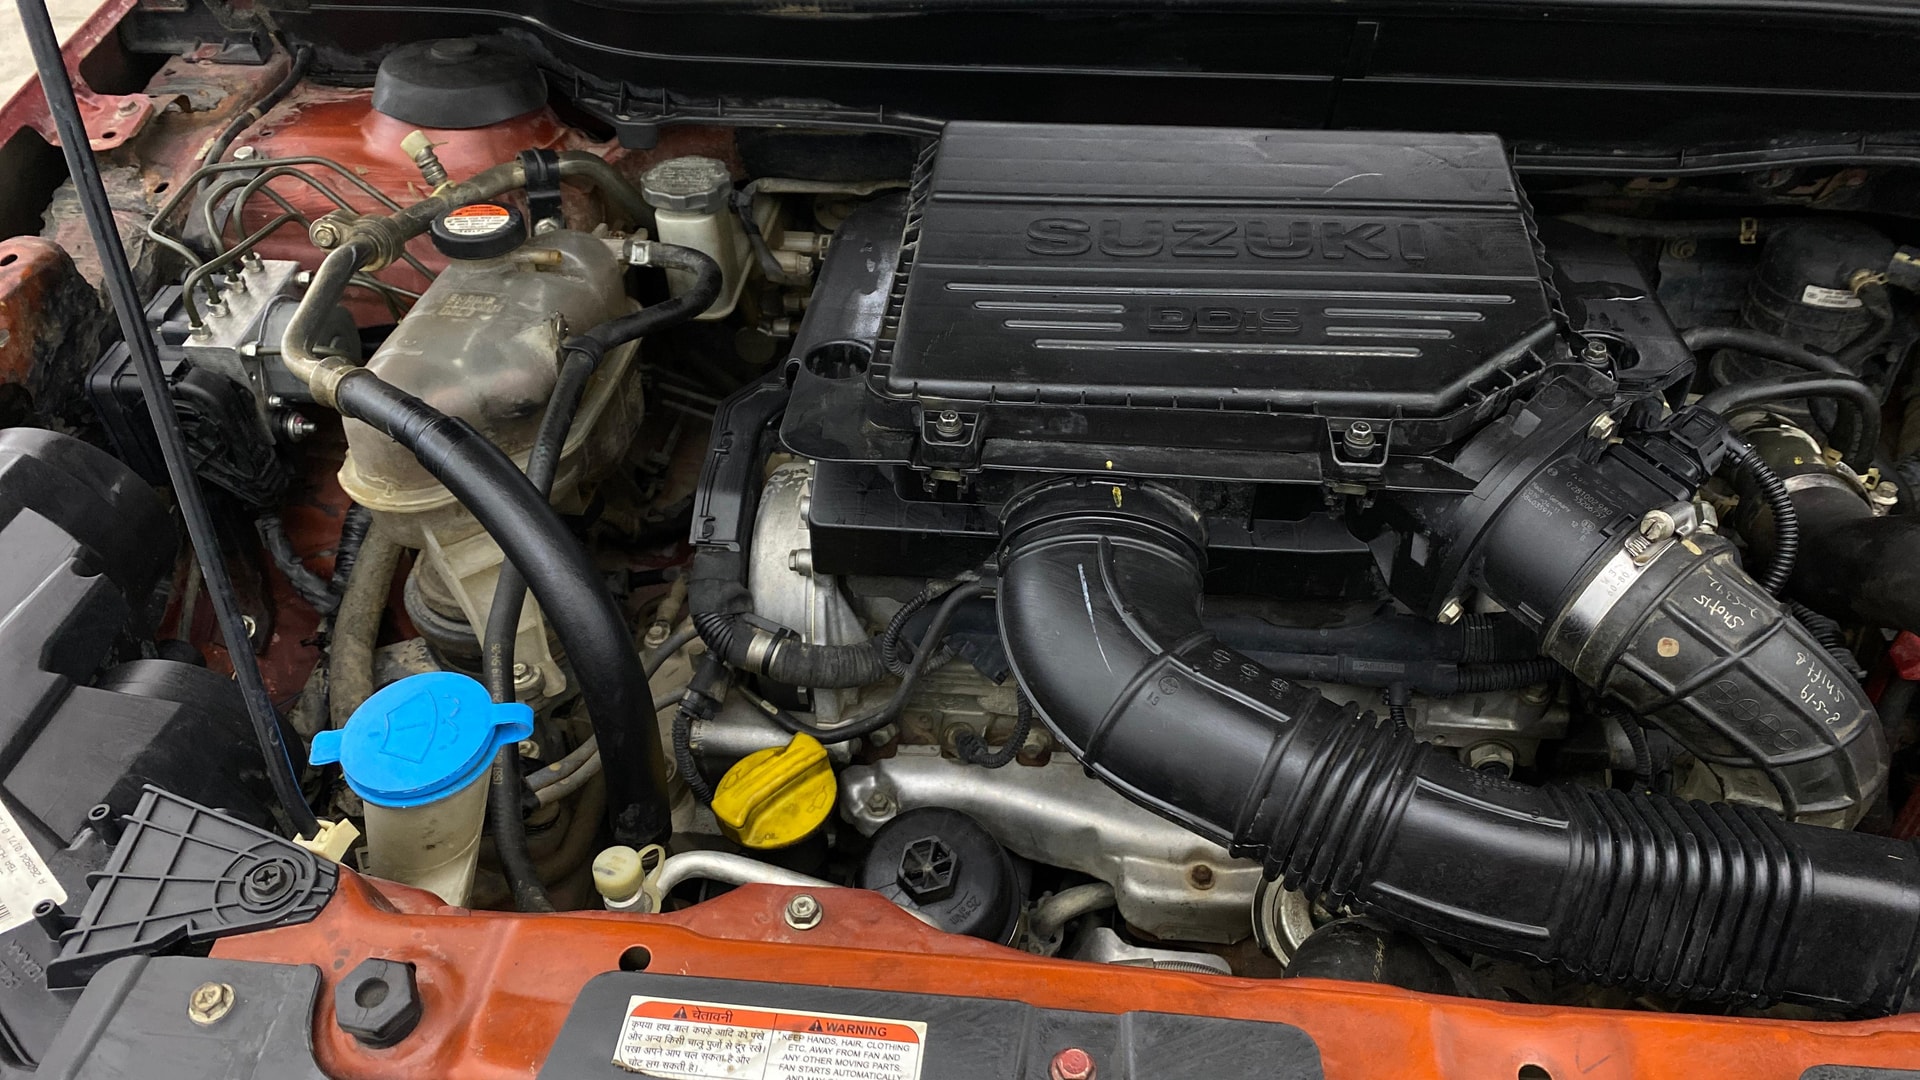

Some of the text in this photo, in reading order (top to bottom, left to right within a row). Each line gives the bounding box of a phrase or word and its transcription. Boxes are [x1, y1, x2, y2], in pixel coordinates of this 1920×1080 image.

[1025, 218, 1427, 260] SUZUKI
[1147, 306, 1302, 333] DDiS
[692, 1007, 733, 1023] चेतावनी
[632, 1020, 653, 1031] कृपया
[674, 1025, 689, 1033] बाल
[715, 1027, 734, 1037] आदि
[738, 1028, 748, 1039] को
[825, 1022, 887, 1037] WARNING
[628, 1031, 643, 1041] और
[645, 1035, 662, 1043] अन्य
[665, 1034, 685, 1045] किसी
[688, 1039, 704, 1050] चालू
[725, 1040, 732, 1050] से
[735, 1043, 746, 1053] दूर
[782, 1033, 805, 1042] KEEP
[807, 1036, 838, 1046] HANDS,
[867, 1041, 910, 1052] CLOTHING
[644, 1045, 662, 1055] अपने
[665, 1049, 681, 1058] आप
[684, 1050, 698, 1059] चल
[701, 1052, 724, 1062] सकता
[727, 1052, 734, 1063] है
[736, 1054, 751, 1064] और
[809, 1046, 833, 1055] AWAY
[835, 1049, 860, 1057] FROM
[863, 1051, 880, 1059] FAN
[882, 1052, 901, 1061] AND
[629, 1056, 643, 1067] चोट
[646, 1060, 659, 1068] लग
[663, 1060, 685, 1072] सकती
[779, 1064, 796, 1072] FAN
[798, 1066, 831, 1075] STARTS
[833, 1069, 903, 1080] AUTOMATICALLY
[782, 1054, 902, 1072] ANY OTHER MOVING PARTS.
